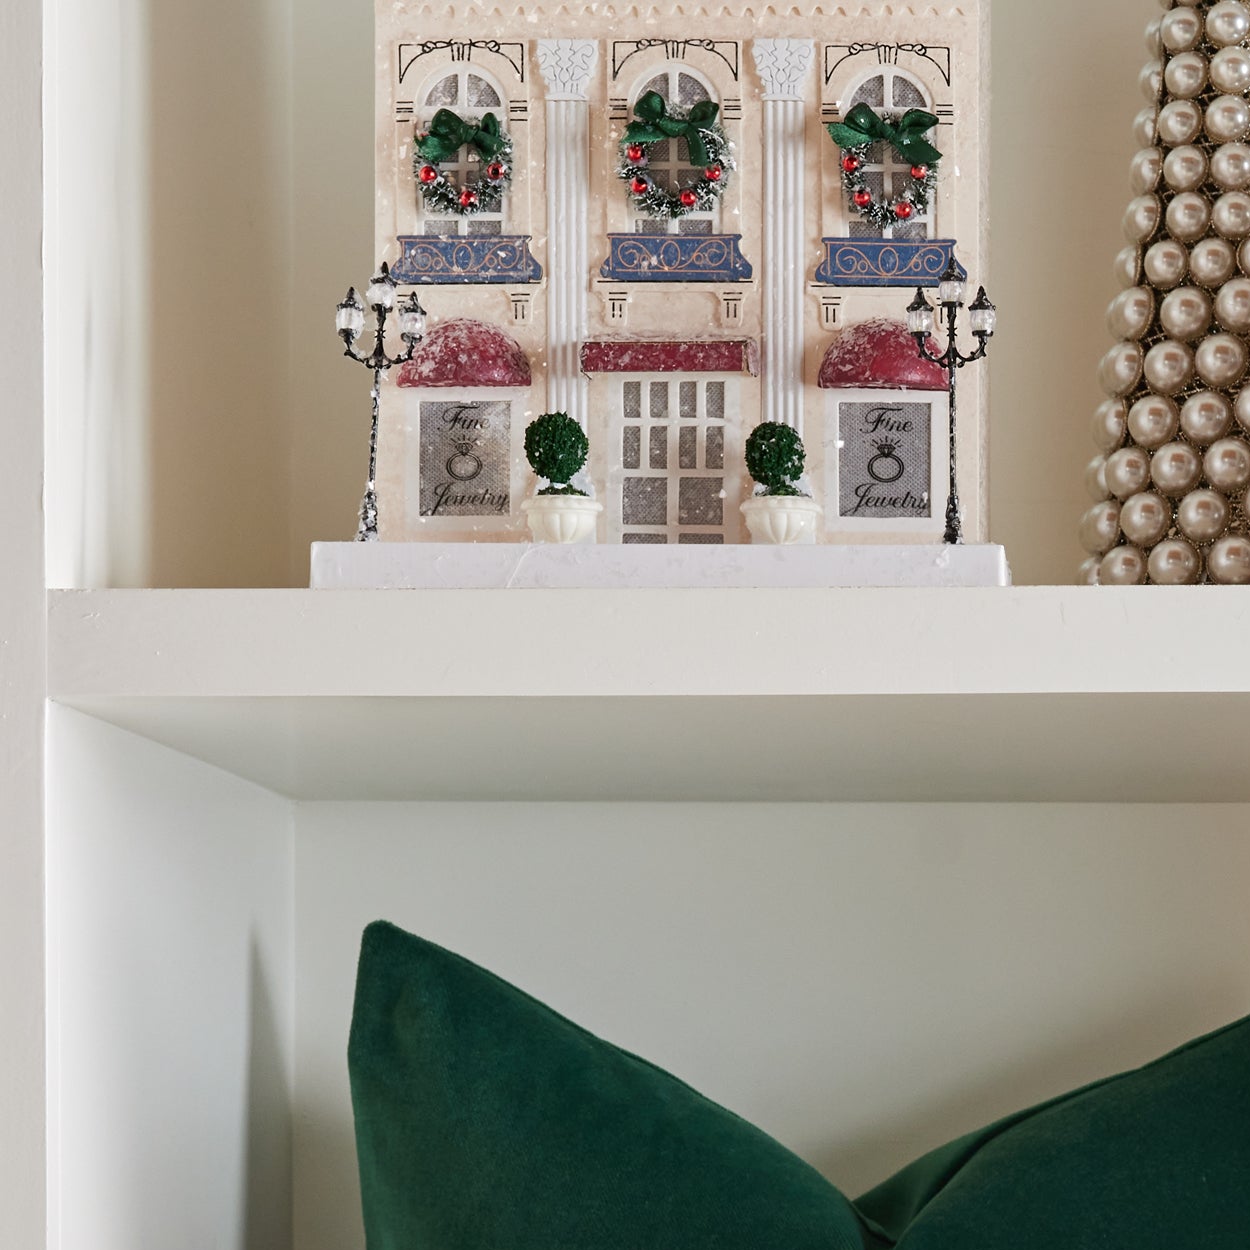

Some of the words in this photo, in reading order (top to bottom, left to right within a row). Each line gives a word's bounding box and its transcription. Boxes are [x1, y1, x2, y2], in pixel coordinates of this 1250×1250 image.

[437, 405, 491, 432] Fine
[860, 407, 914, 434] Fine
[420, 482, 509, 516] Jewelry
[840, 482, 928, 516] Jewelry
